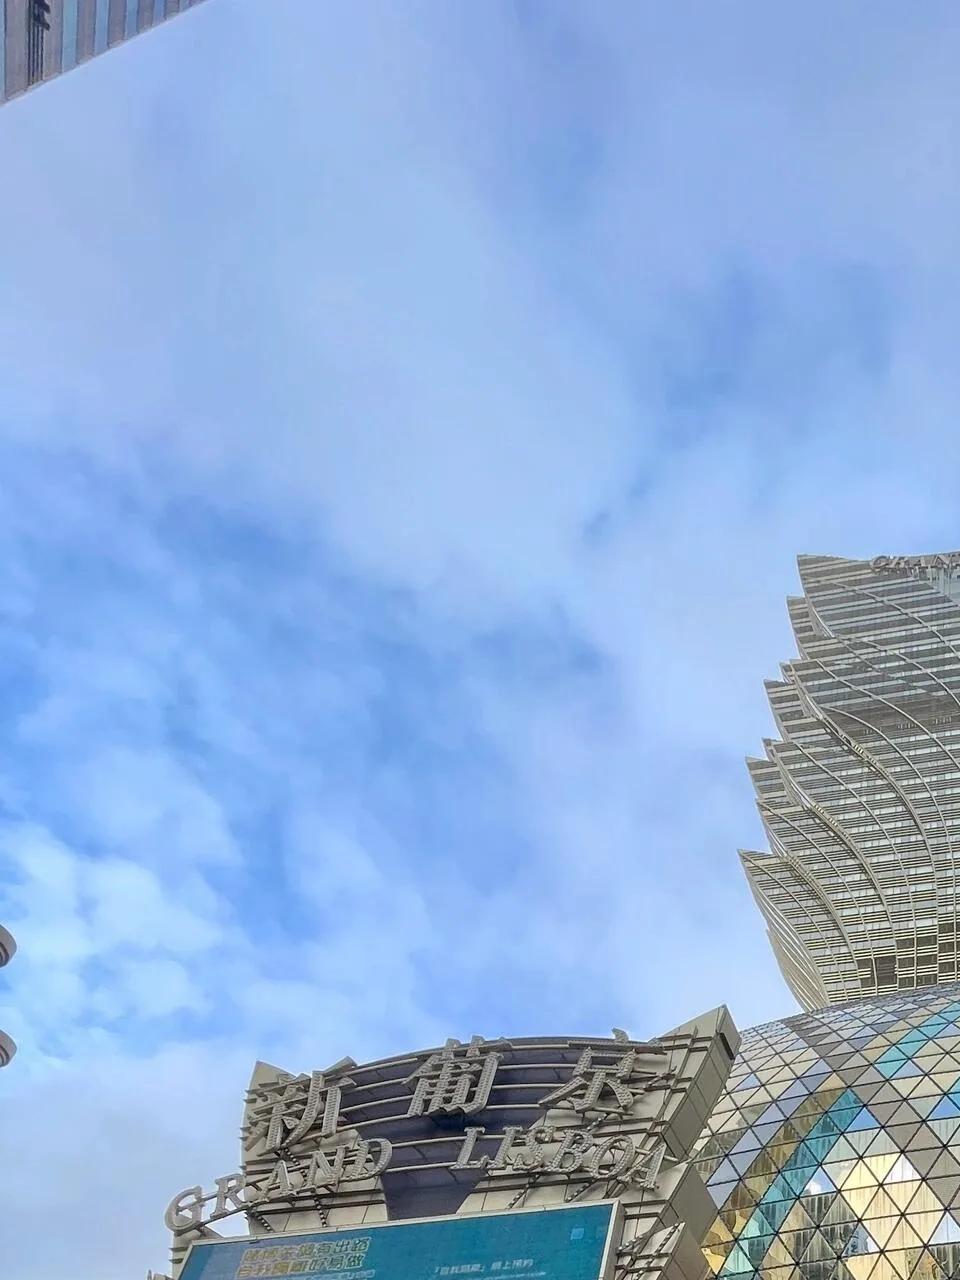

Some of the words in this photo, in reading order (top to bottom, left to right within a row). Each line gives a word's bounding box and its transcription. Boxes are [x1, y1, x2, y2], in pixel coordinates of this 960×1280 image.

[245, 1028, 664, 1151] 新葡京
[164, 1138, 392, 1231] GRAND
[451, 1126, 667, 1190] LISBOA
